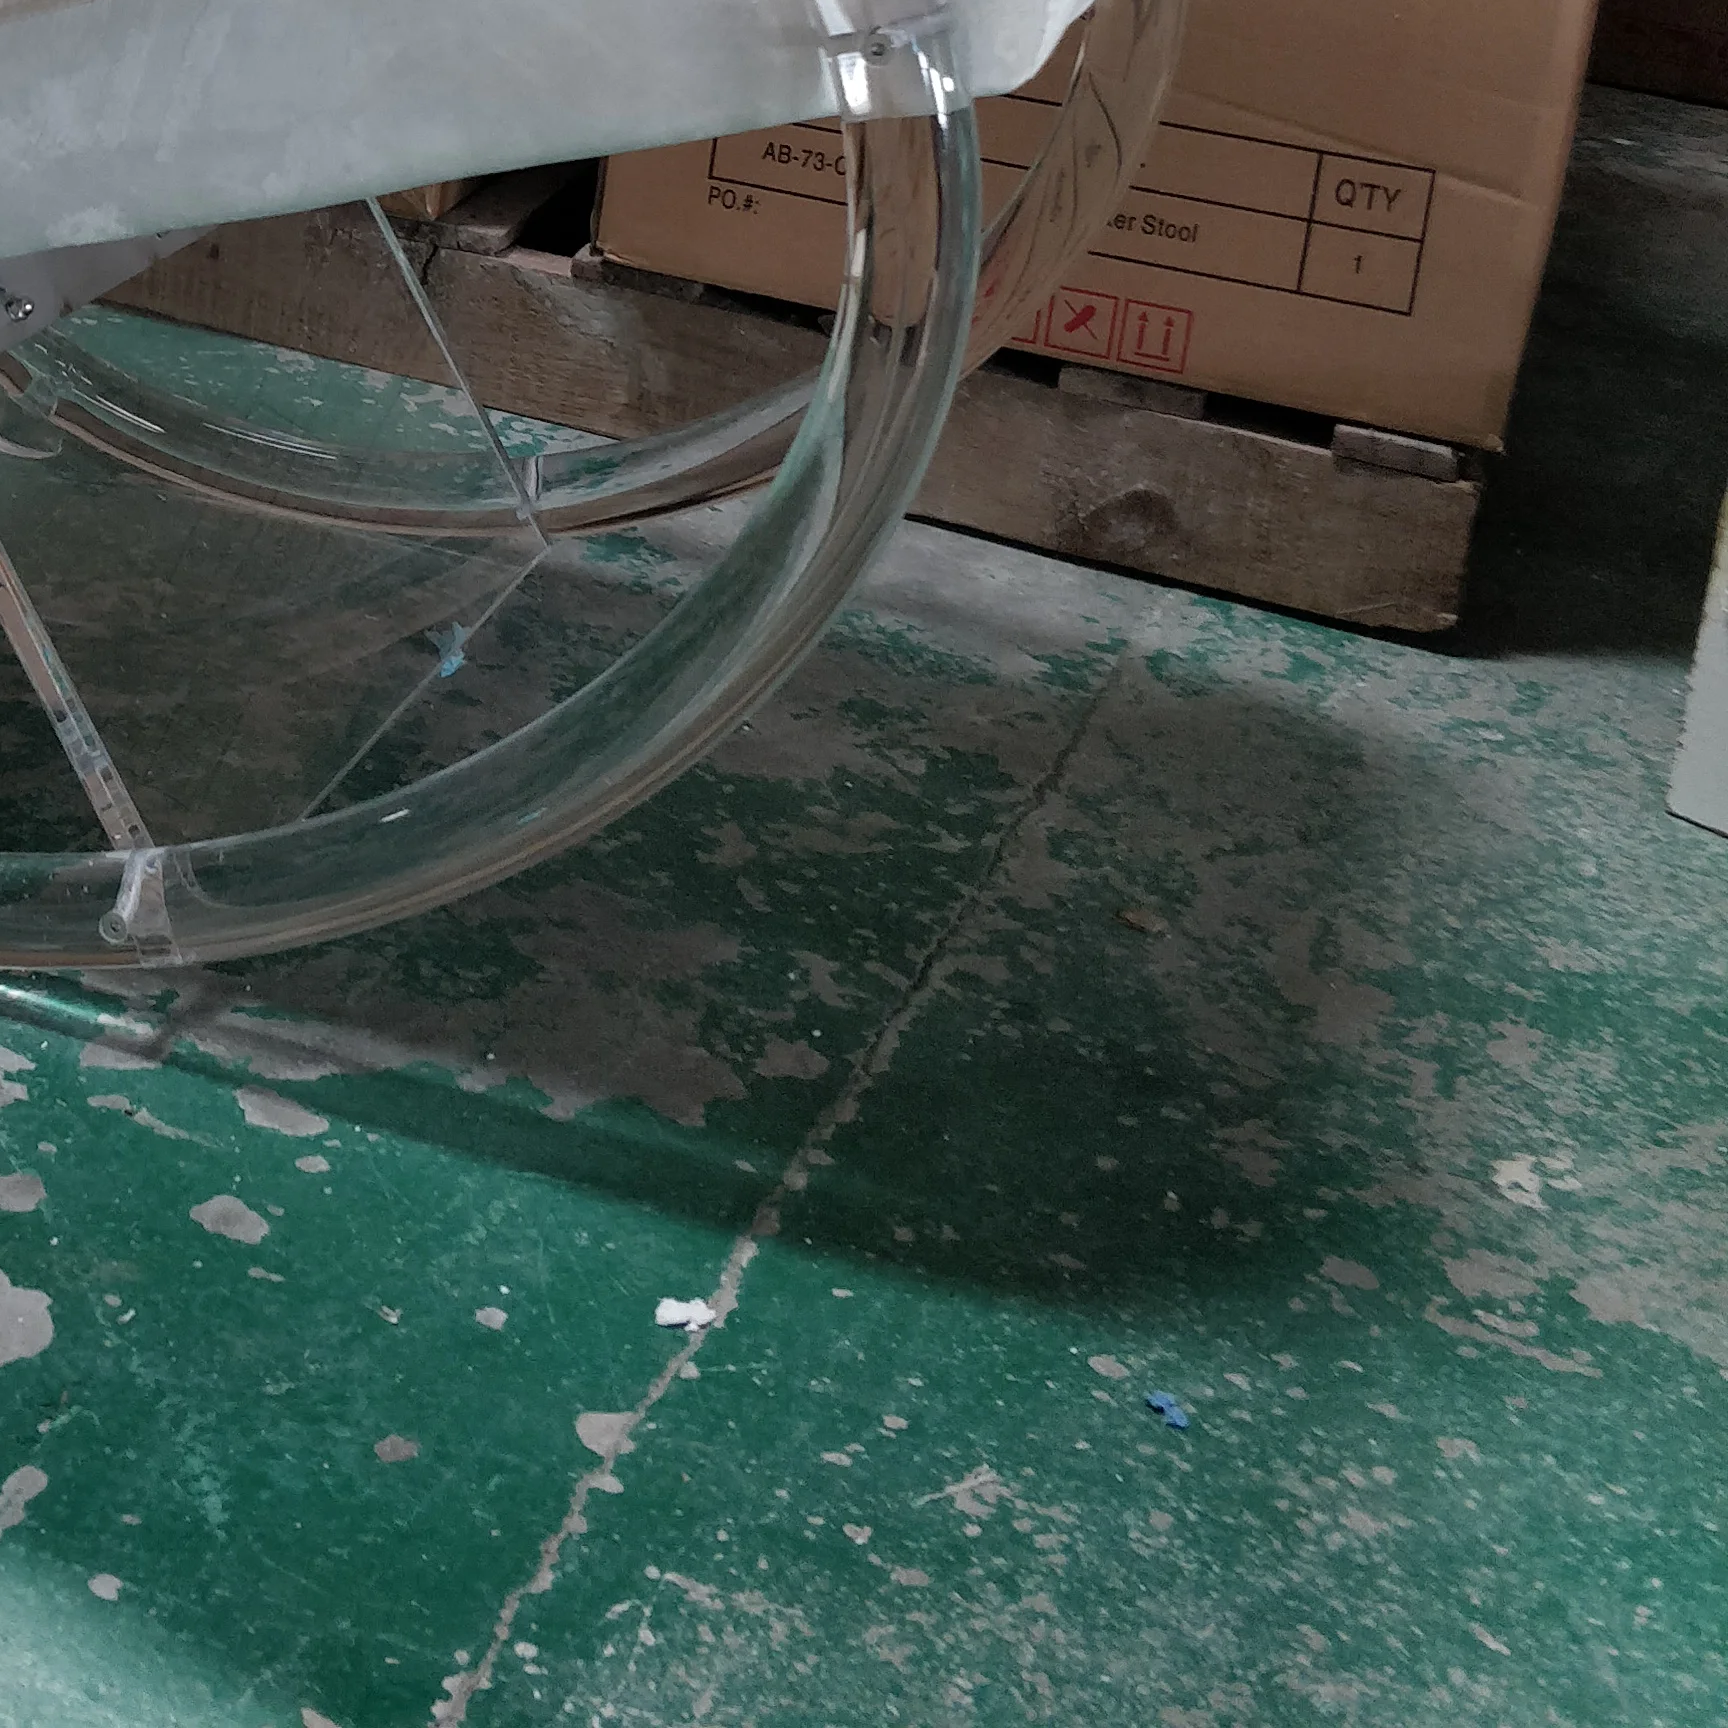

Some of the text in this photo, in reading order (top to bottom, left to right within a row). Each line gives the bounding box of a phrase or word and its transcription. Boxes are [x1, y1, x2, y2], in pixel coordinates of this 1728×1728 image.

[761, 141, 847, 177] AB-73-C
[1334, 178, 1403, 213] QTY
[1140, 213, 1201, 243] Stool
[1353, 255, 1364, 275] 1
